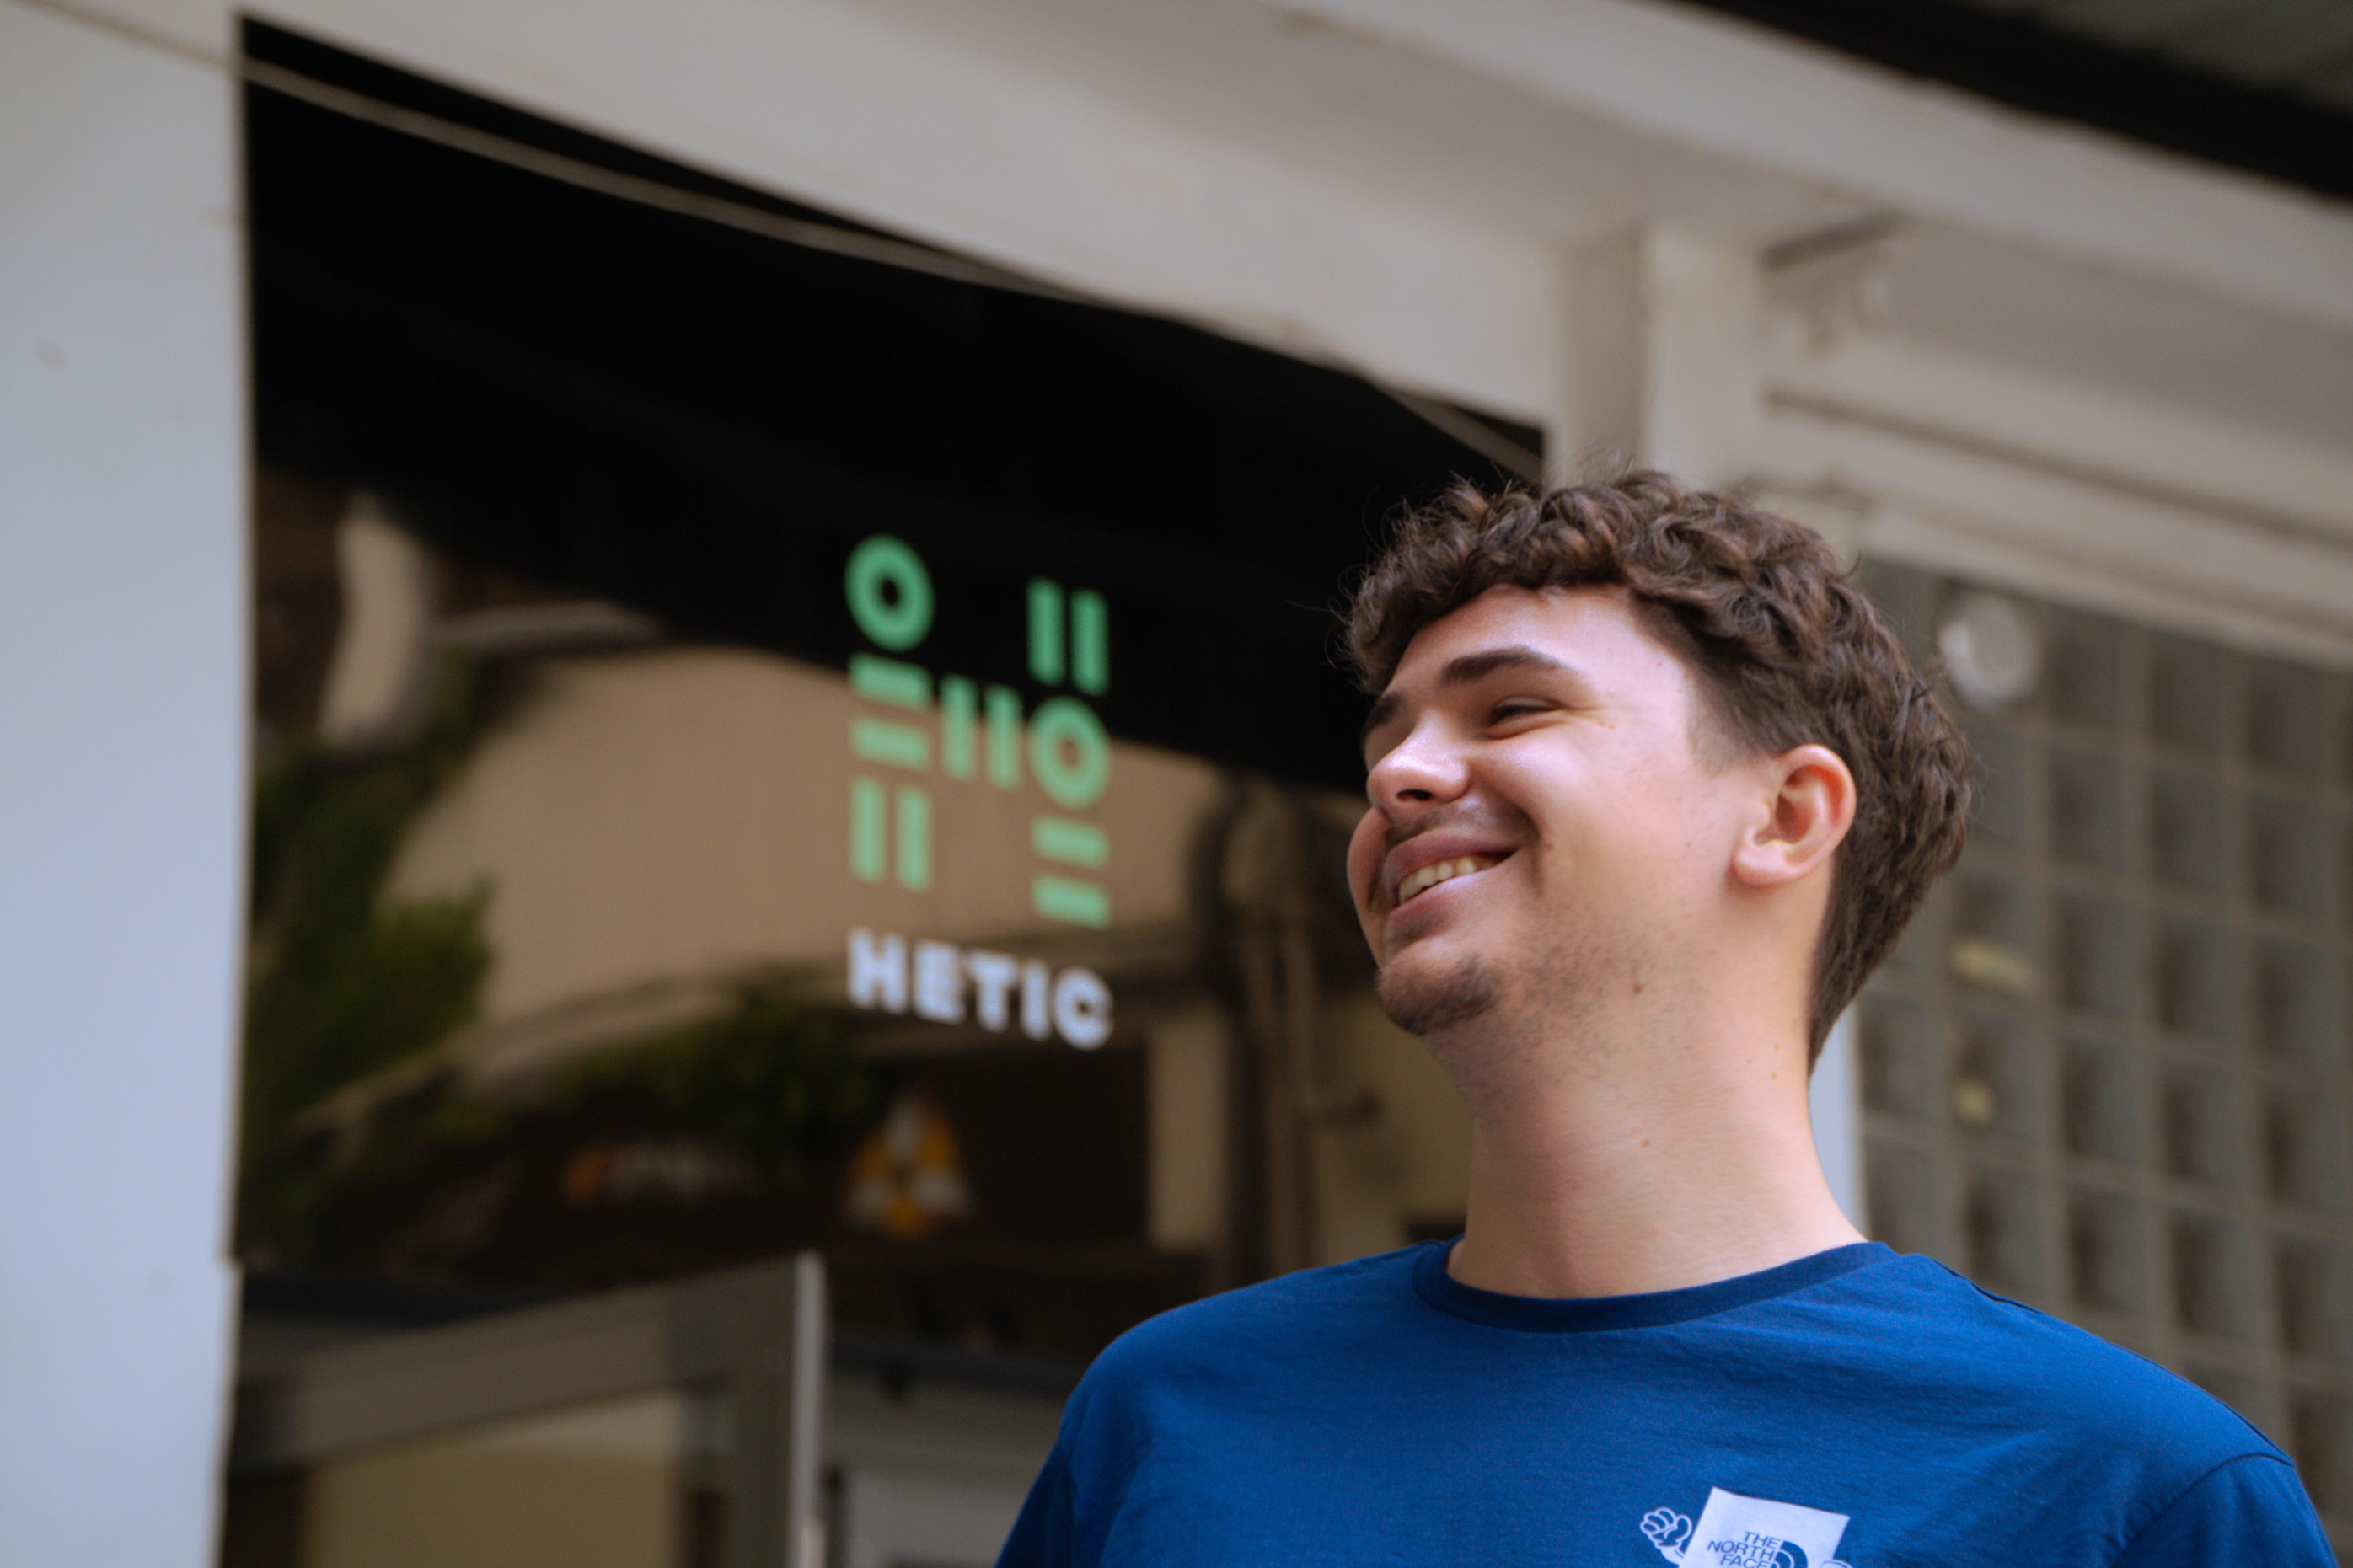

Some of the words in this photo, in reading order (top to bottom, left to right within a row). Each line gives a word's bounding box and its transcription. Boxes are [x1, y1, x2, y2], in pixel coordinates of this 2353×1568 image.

[847, 928, 1113, 1051] HETIC
[1744, 1530, 1781, 1549] THE
[1707, 1540, 1776, 1560] NORTH
